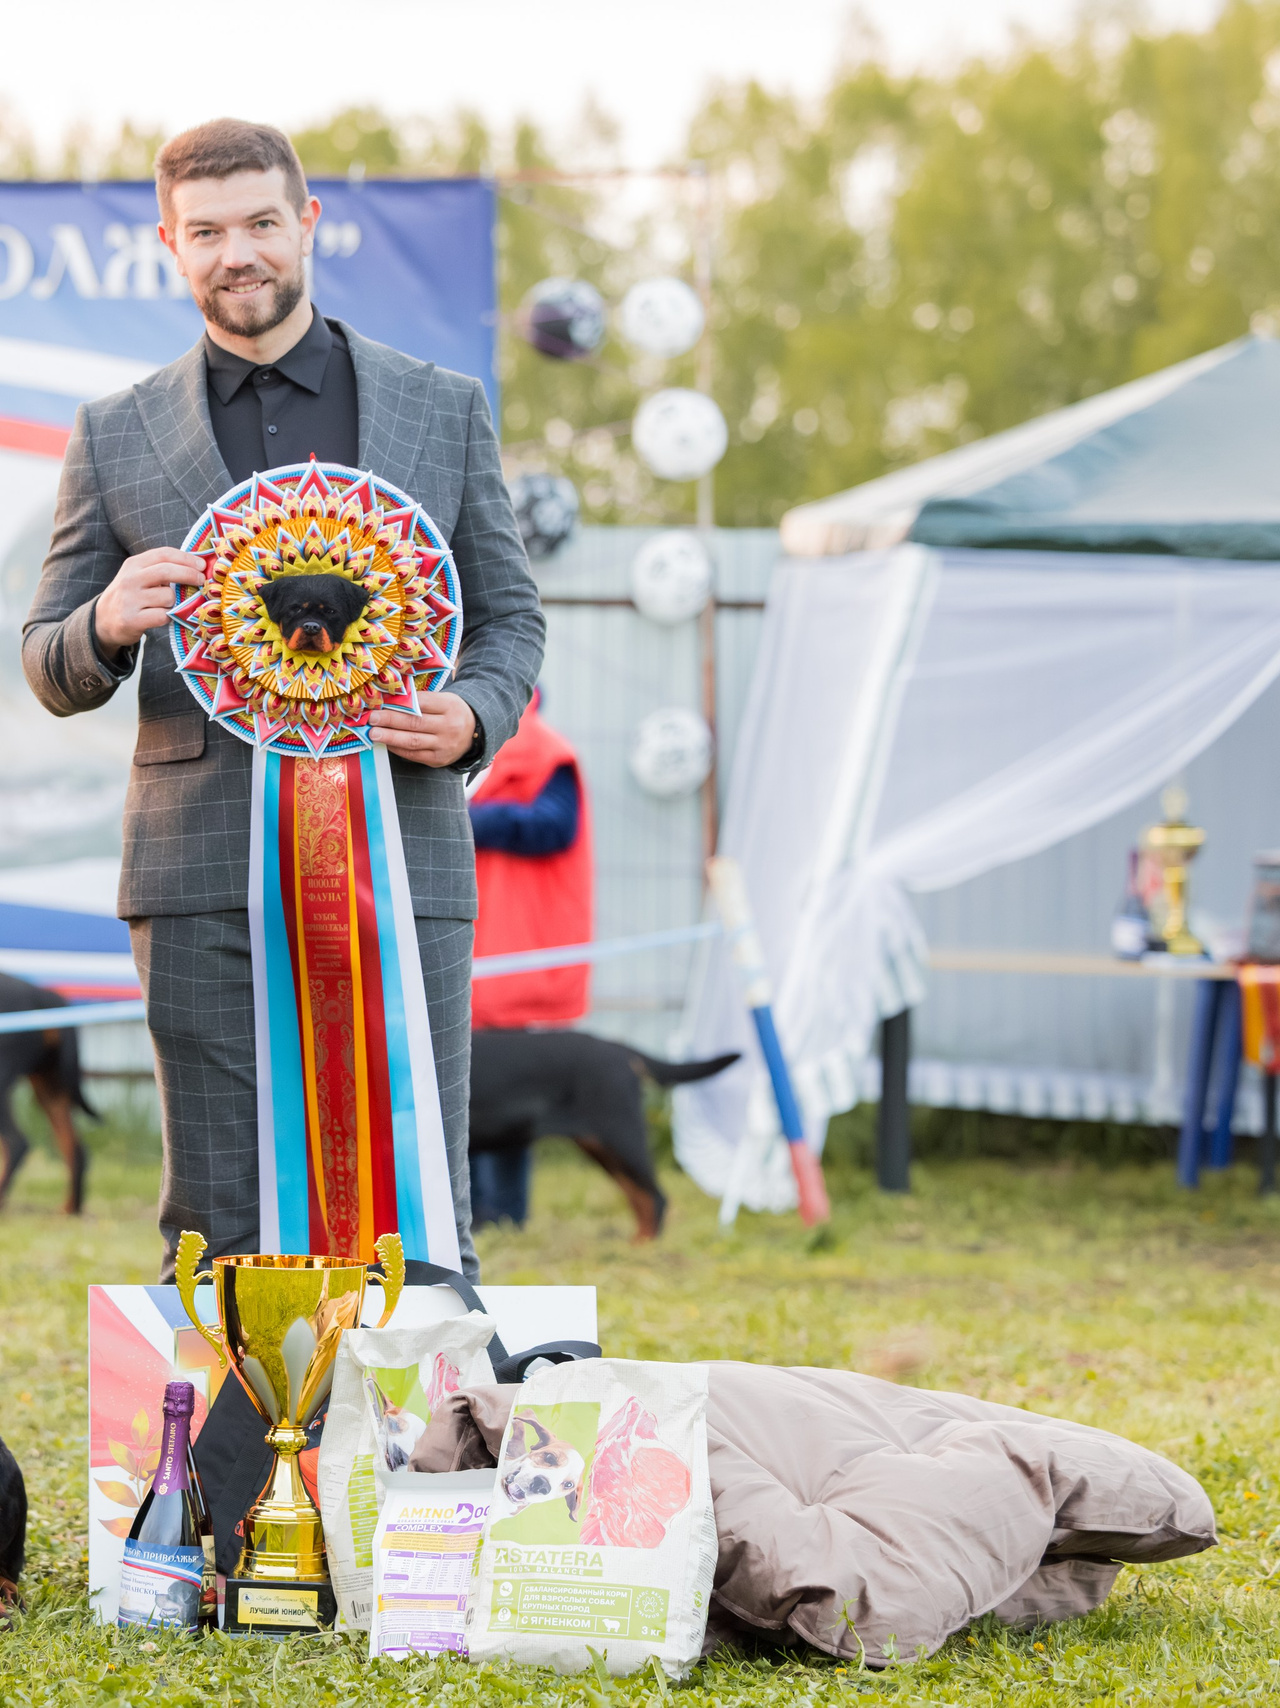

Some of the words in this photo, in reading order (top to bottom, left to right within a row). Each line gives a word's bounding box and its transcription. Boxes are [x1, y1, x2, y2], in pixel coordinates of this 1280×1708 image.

[163, 1456, 173, 1480] SANTO
[168, 1422, 177, 1455] STEFANO
[395, 1524, 444, 1532] COMPLEX
[536, 1567, 585, 1576] BALANCE
[524, 1586, 605, 1597] СБАЛАНСИРОВАННЫЙ
[606, 1590, 628, 1598] КОРМ
[523, 1594, 540, 1602] ДЛЯ
[542, 1595, 587, 1604] ВЗРОСЛЫХ
[588, 1598, 615, 1606] СОБАК
[249, 1606, 279, 1615] ЛУЧШИЙ
[281, 1608, 307, 1616] ЮНИОР
[522, 1604, 560, 1612] КРУПНЫХ
[561, 1605, 591, 1614] ПОРОД
[521, 1616, 528, 1625] С
[531, 1617, 591, 1628] ЯГНЕНКОМ
[641, 1626, 648, 1635] 3
[650, 1629, 662, 1637] кг
